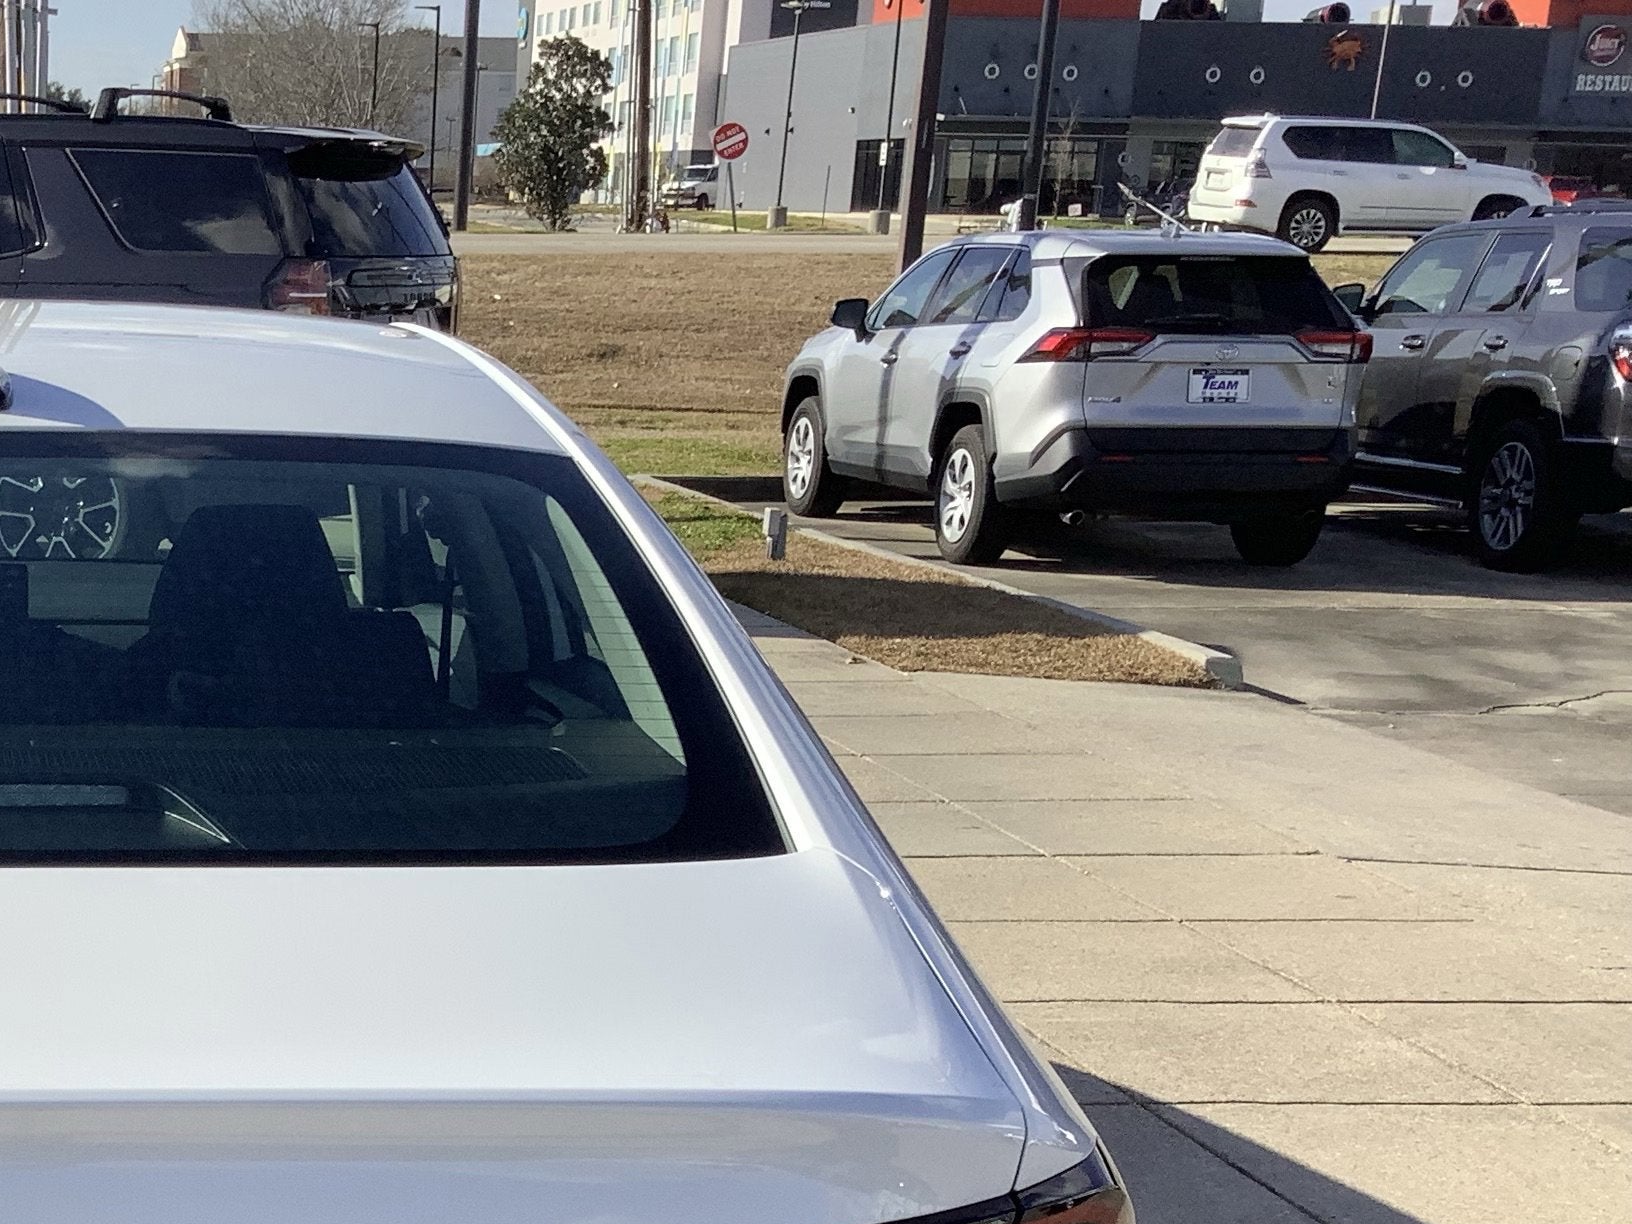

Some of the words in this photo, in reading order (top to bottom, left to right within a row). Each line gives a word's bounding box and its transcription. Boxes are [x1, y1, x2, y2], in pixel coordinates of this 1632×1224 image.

[1575, 74, 1632, 91] RESTAU
[715, 133, 726, 142] DO
[726, 126, 740, 137] NOT
[723, 142, 745, 157] ENTER
[1202, 374, 1239, 391] TEAM
